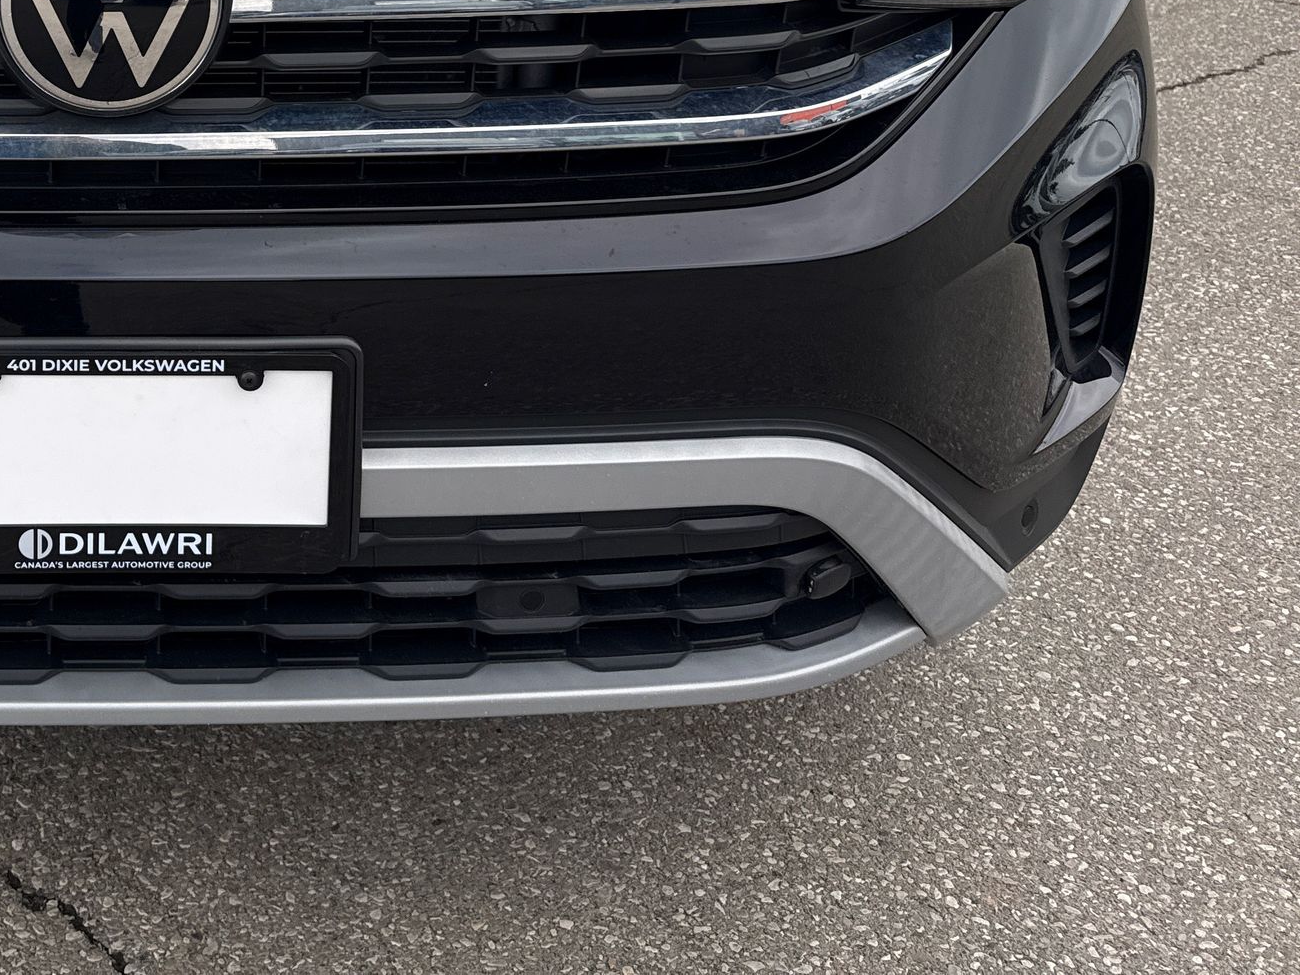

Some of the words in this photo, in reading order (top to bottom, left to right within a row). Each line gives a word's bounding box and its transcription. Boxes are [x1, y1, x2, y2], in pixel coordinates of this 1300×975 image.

[6, 359, 37, 372] 401
[42, 359, 90, 372] DIXIE
[94, 359, 225, 372] VOLKSWAGEN
[59, 532, 213, 555] DILAWRI
[14, 561, 64, 569] CANADA'S
[66, 561, 109, 569] LARGEST
[111, 561, 175, 569] AUTOMOTIVE
[177, 561, 212, 569] GROUP
